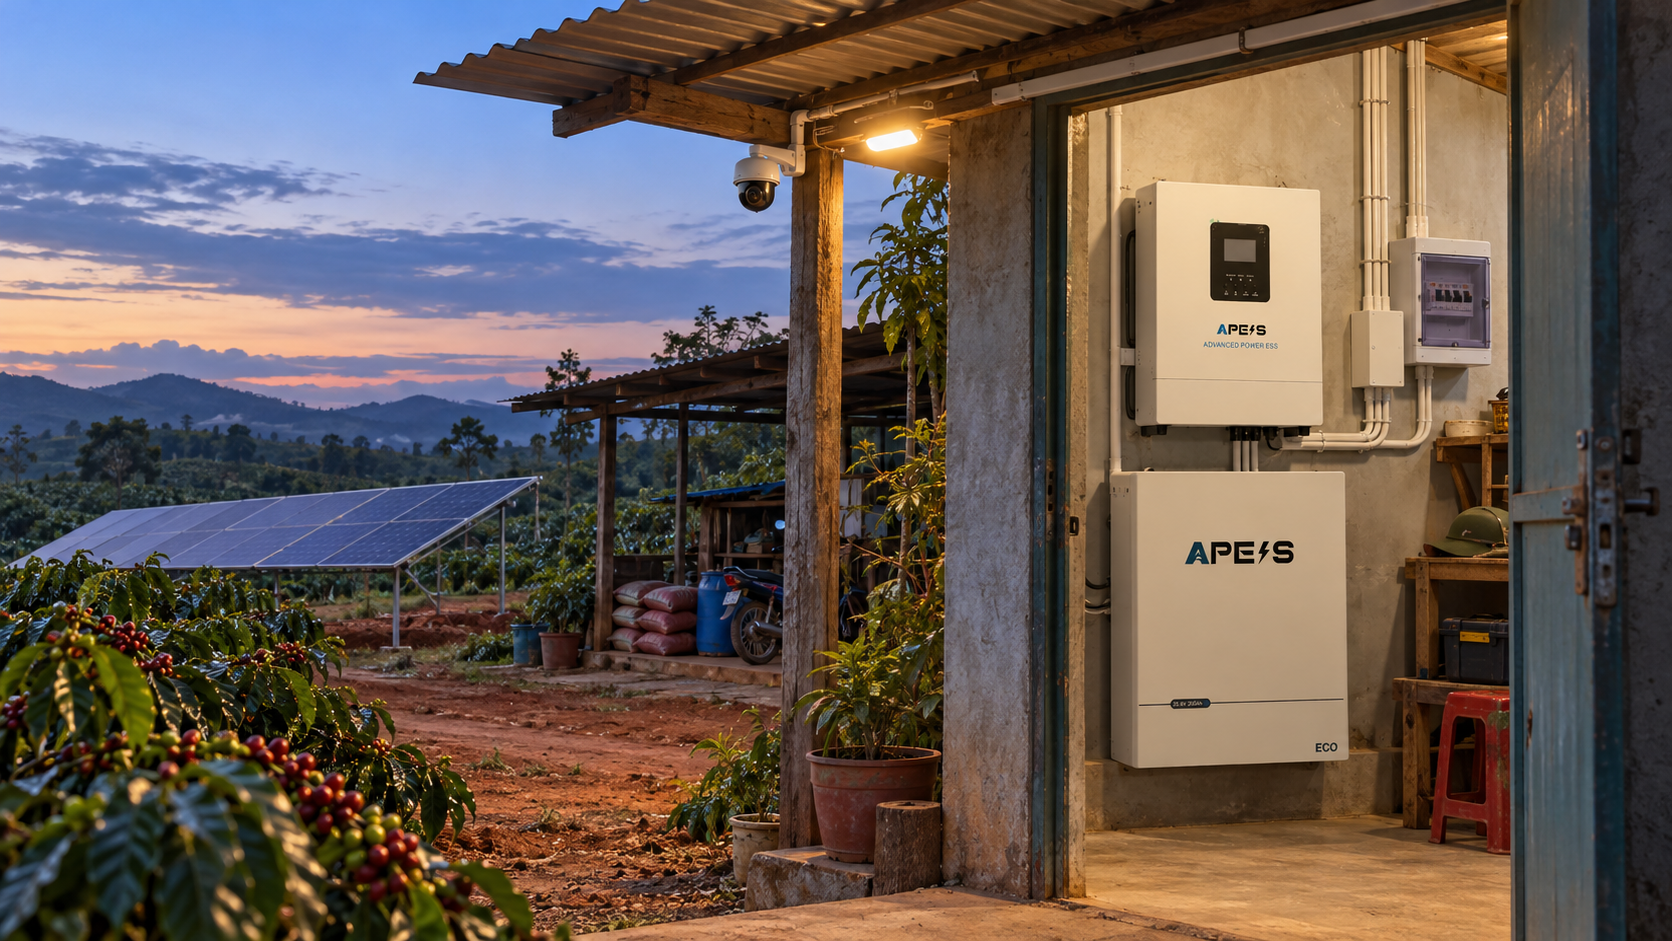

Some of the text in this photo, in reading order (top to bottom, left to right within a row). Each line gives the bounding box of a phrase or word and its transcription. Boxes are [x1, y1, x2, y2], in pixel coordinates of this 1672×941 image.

[1203, 341, 1279, 350] ADVANCED POWER ESS
[1315, 742, 1338, 753] ECO
